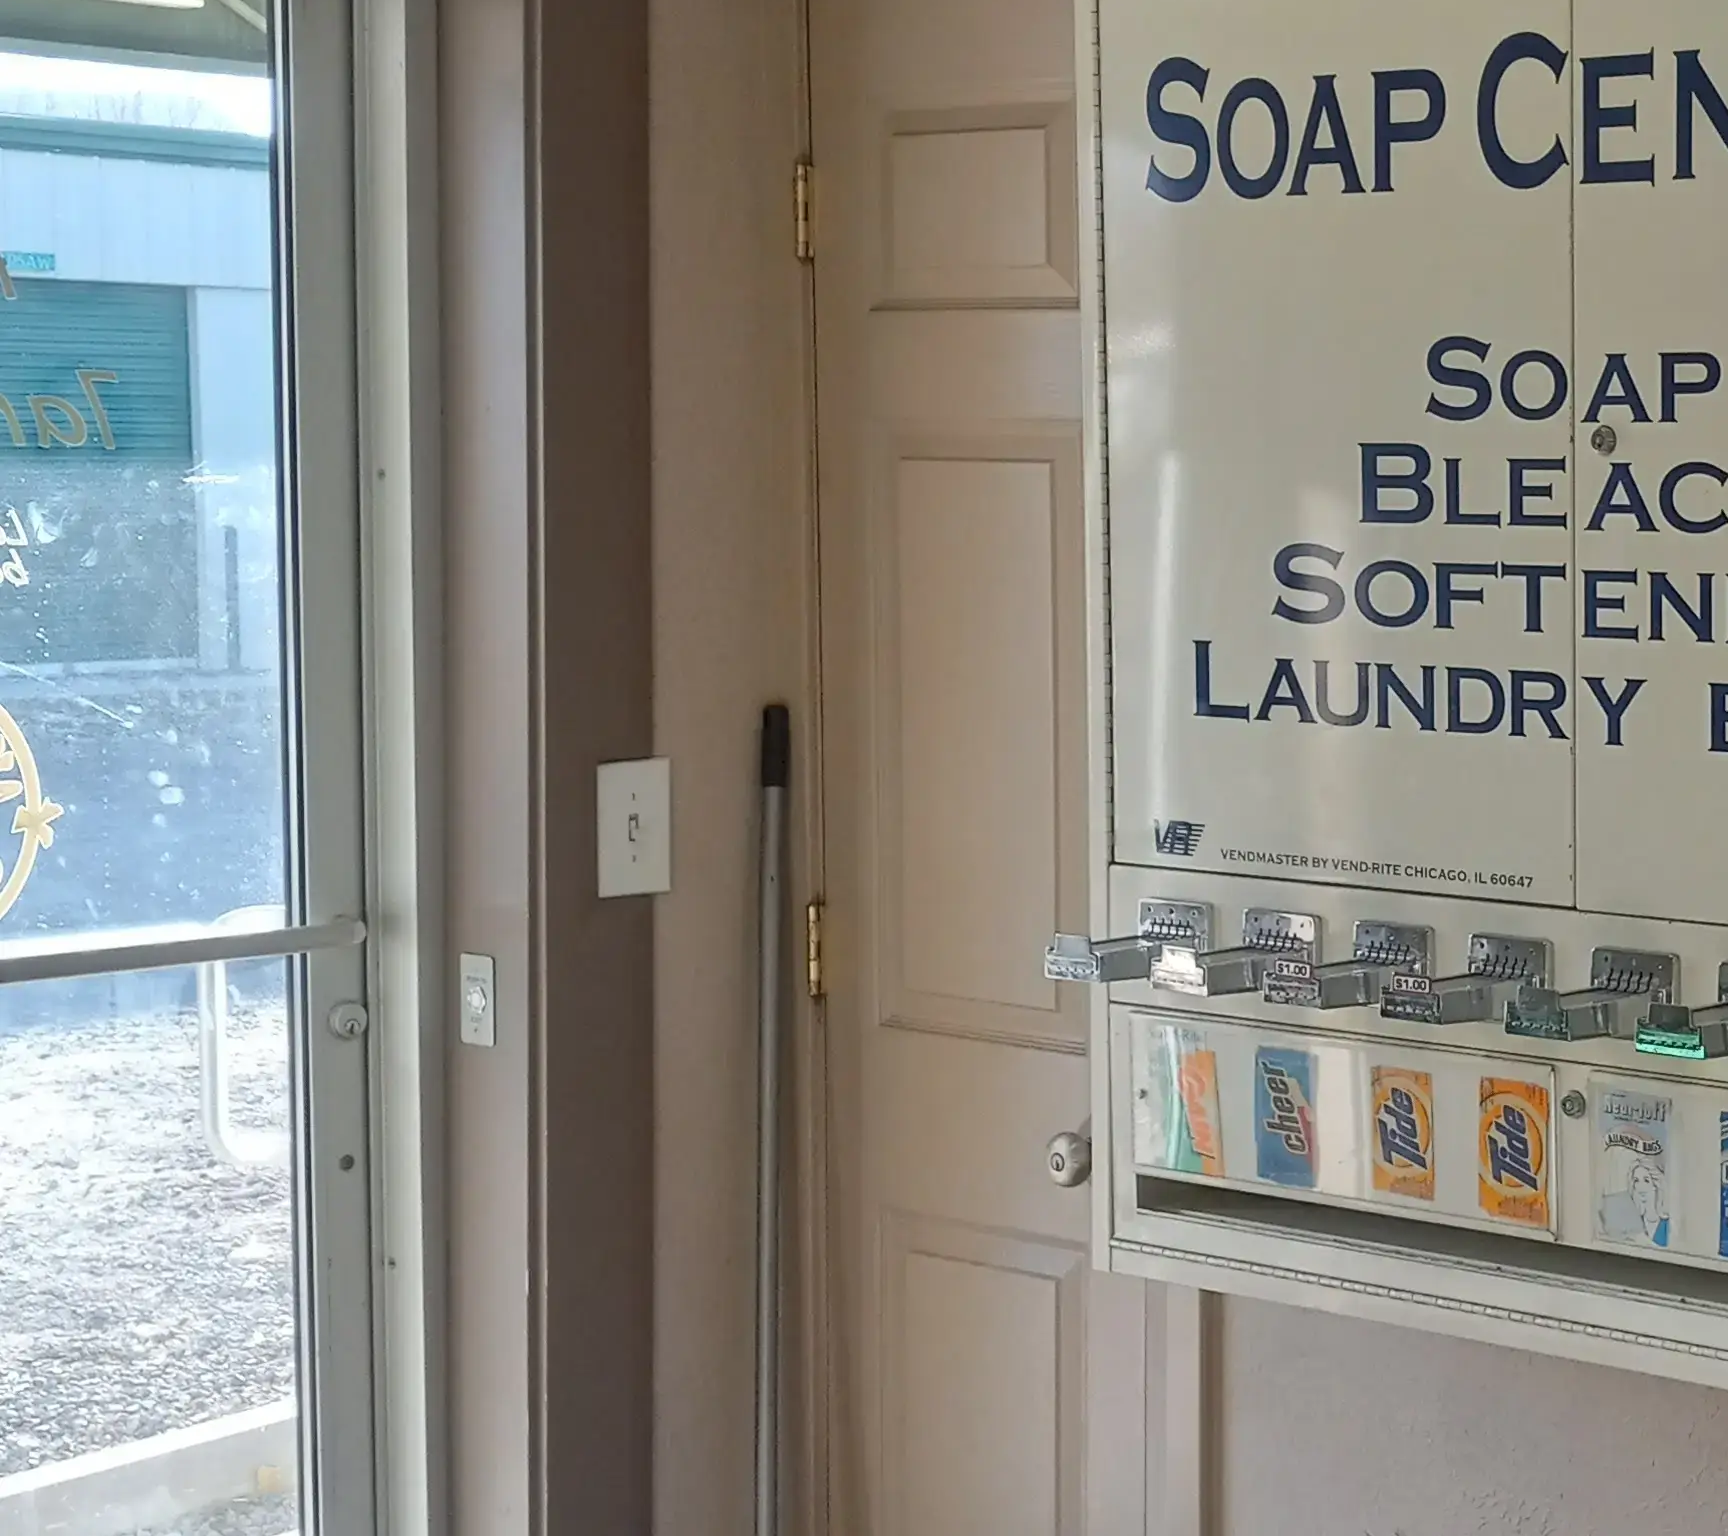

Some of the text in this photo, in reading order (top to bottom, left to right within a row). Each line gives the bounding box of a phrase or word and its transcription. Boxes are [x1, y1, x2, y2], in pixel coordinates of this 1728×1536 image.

[1144, 56, 1446, 202] SOAP
[1425, 336, 1722, 423] SOAP
[1193, 641, 1647, 746] LAUNDRY
[1220, 848, 1534, 888] VENDMASTER BY VEND-RITE CHICAGO, IL 60647
[1277, 963, 1308, 976] $1.00
[1395, 978, 1427, 991] $1.00
[1377, 1087, 1428, 1170] Tide
[1487, 1104, 1539, 1191] Tide
